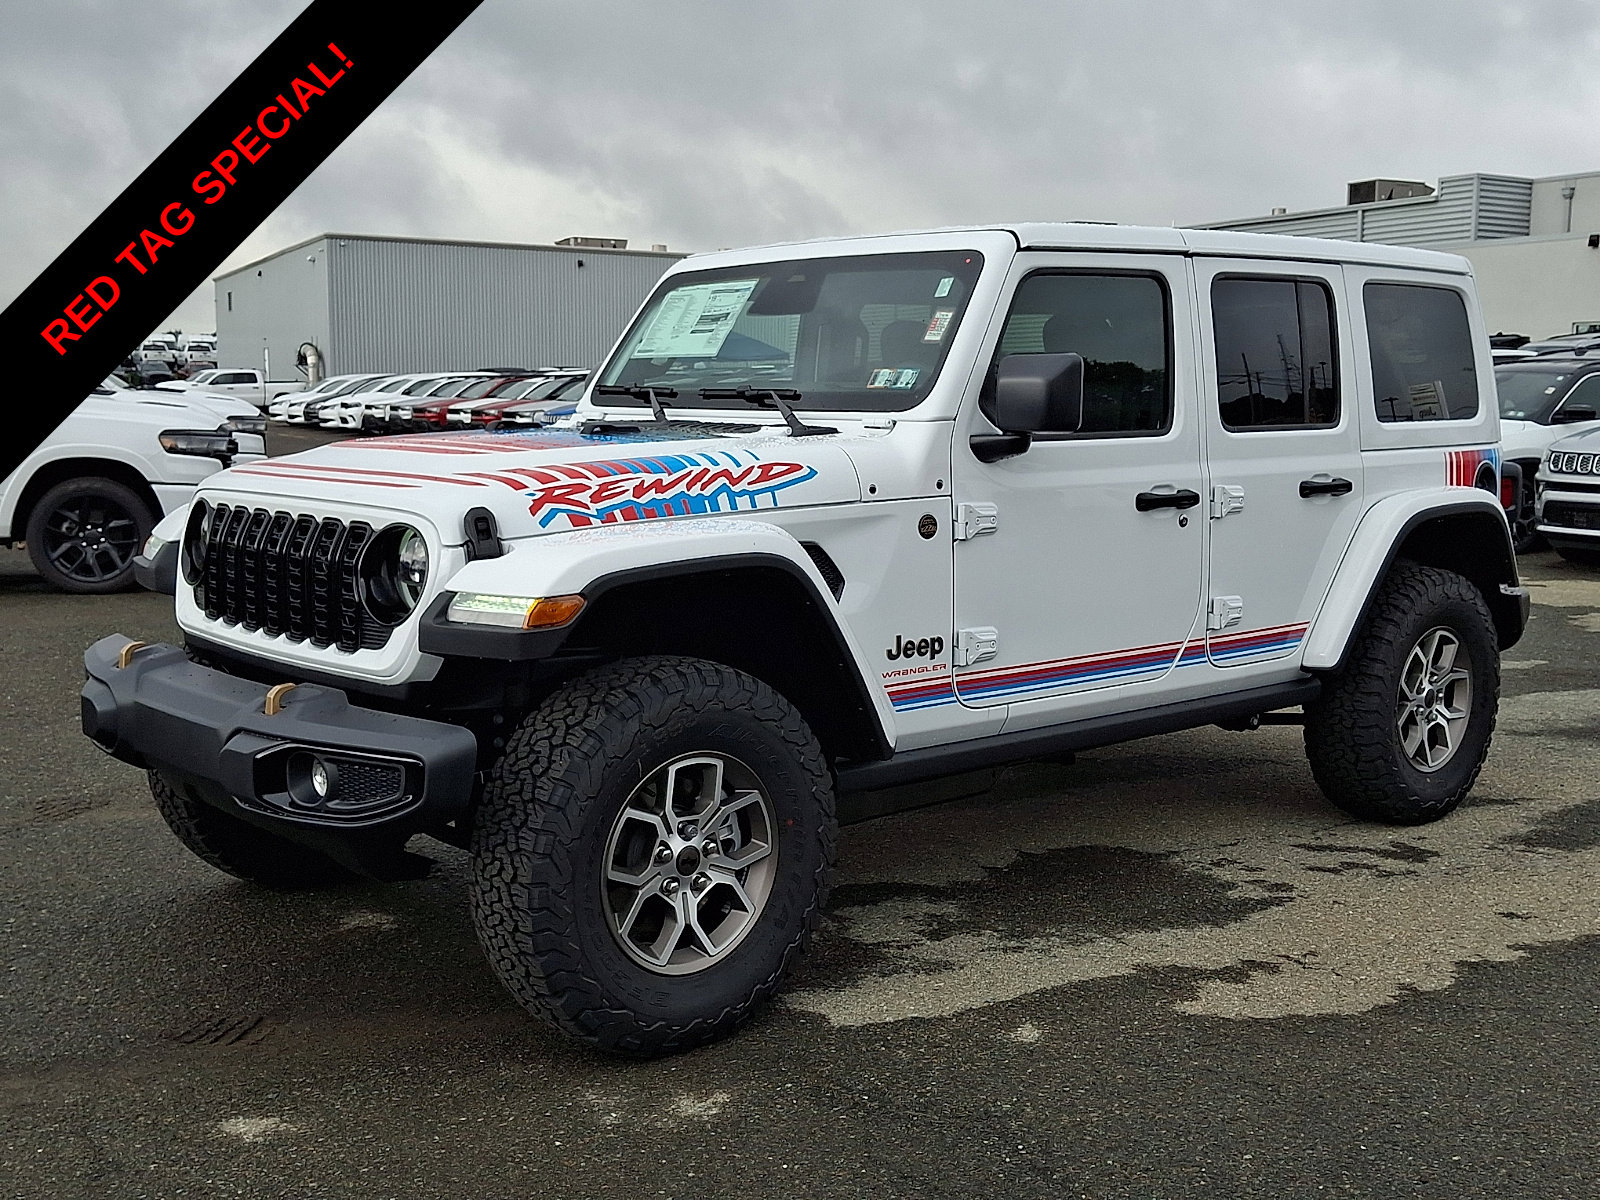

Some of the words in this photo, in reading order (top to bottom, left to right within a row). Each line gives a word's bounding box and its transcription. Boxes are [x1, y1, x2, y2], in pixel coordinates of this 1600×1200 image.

[528, 461, 804, 517] REWIND
[886, 634, 944, 661] Jeep
[881, 663, 948, 679] WRANGLER
